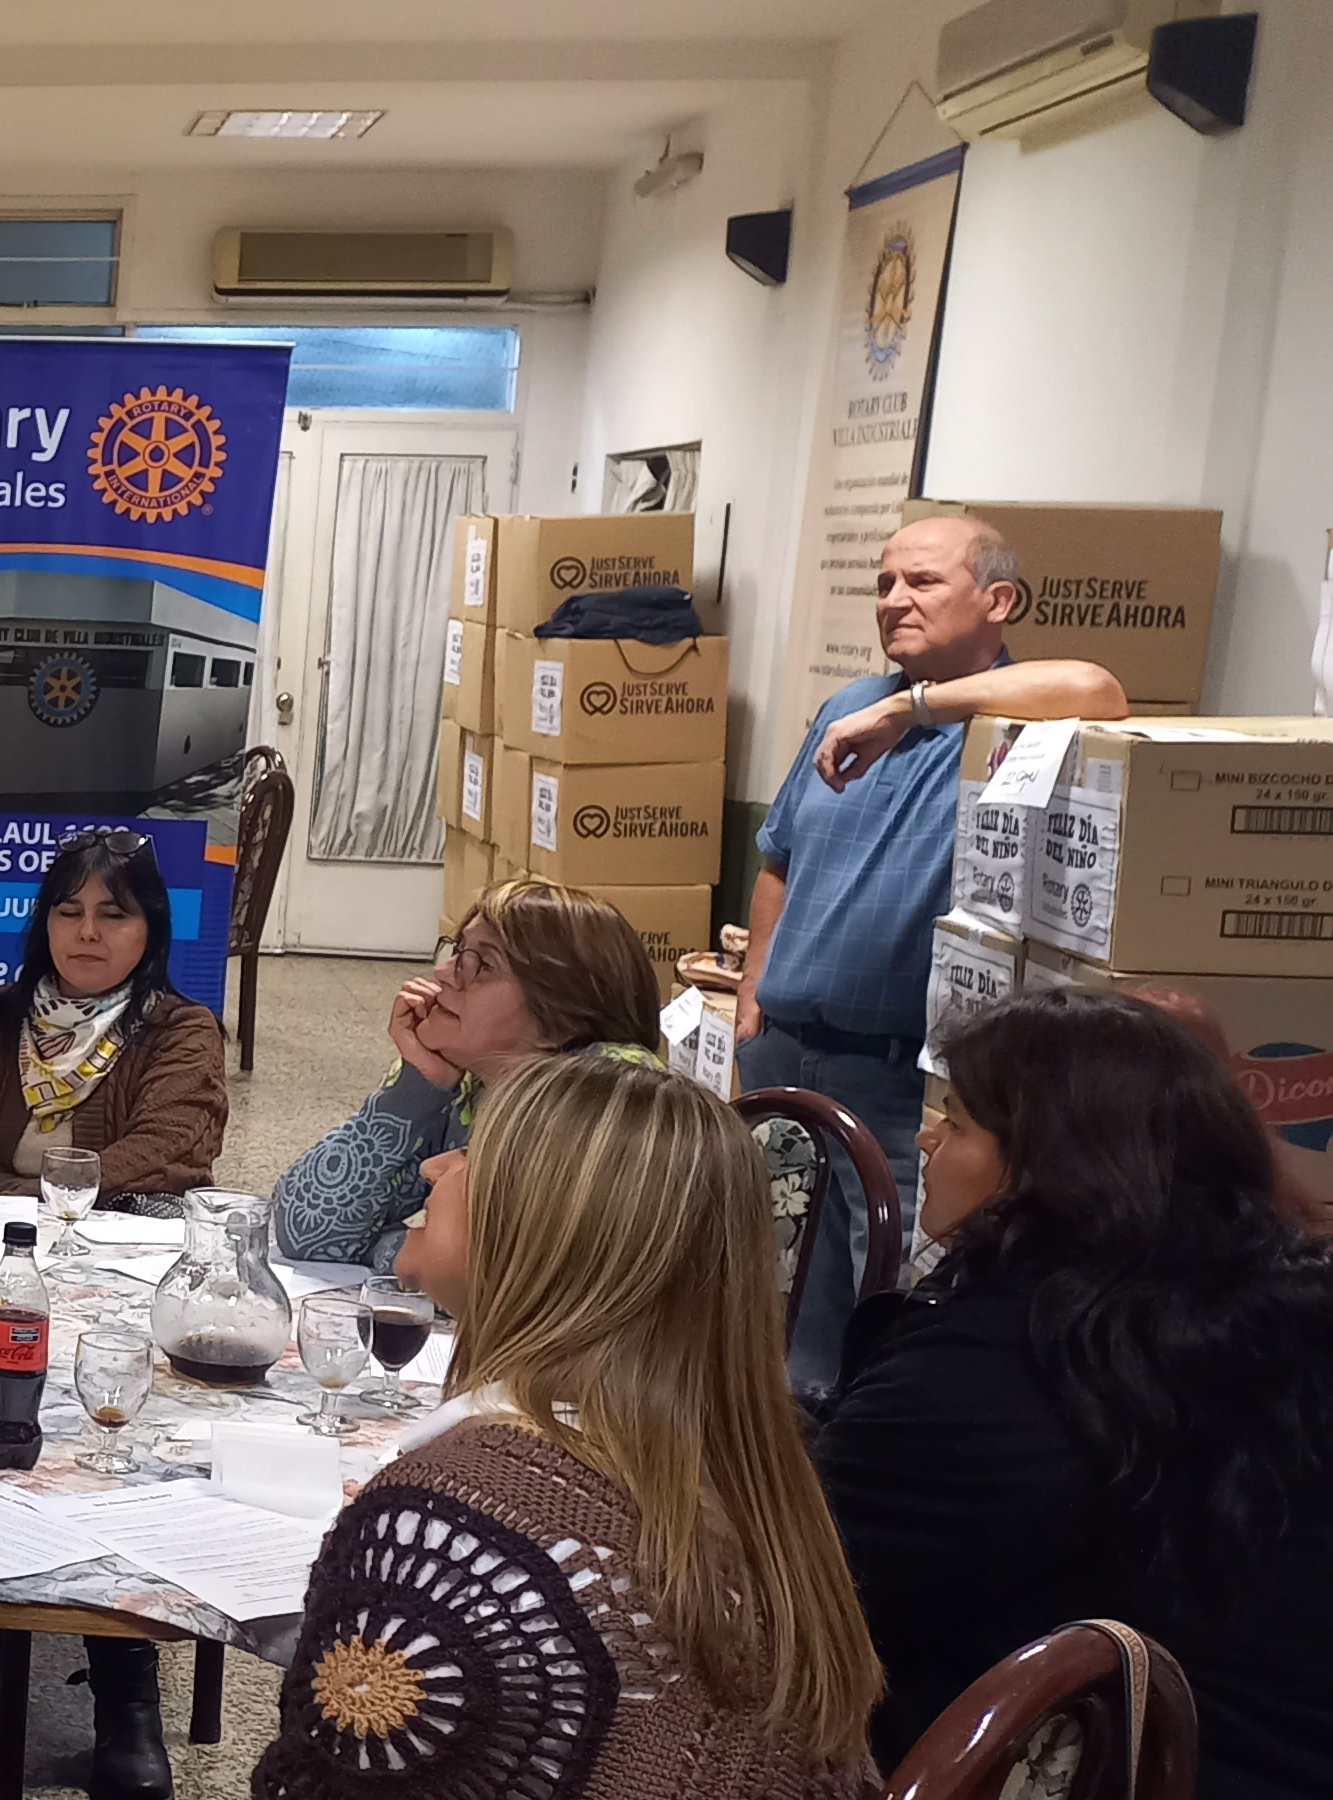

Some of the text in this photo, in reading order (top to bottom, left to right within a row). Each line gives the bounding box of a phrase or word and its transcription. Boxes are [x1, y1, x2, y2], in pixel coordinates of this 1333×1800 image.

[132, 401, 190, 417] ROTARY
[107, 474, 204, 507] INTERNATIONAL
[1215, 772, 1244, 785] MINI
[1248, 773, 1321, 785] BIZCOCHO
[1205, 877, 1319, 890] MINI TRIANGULO
